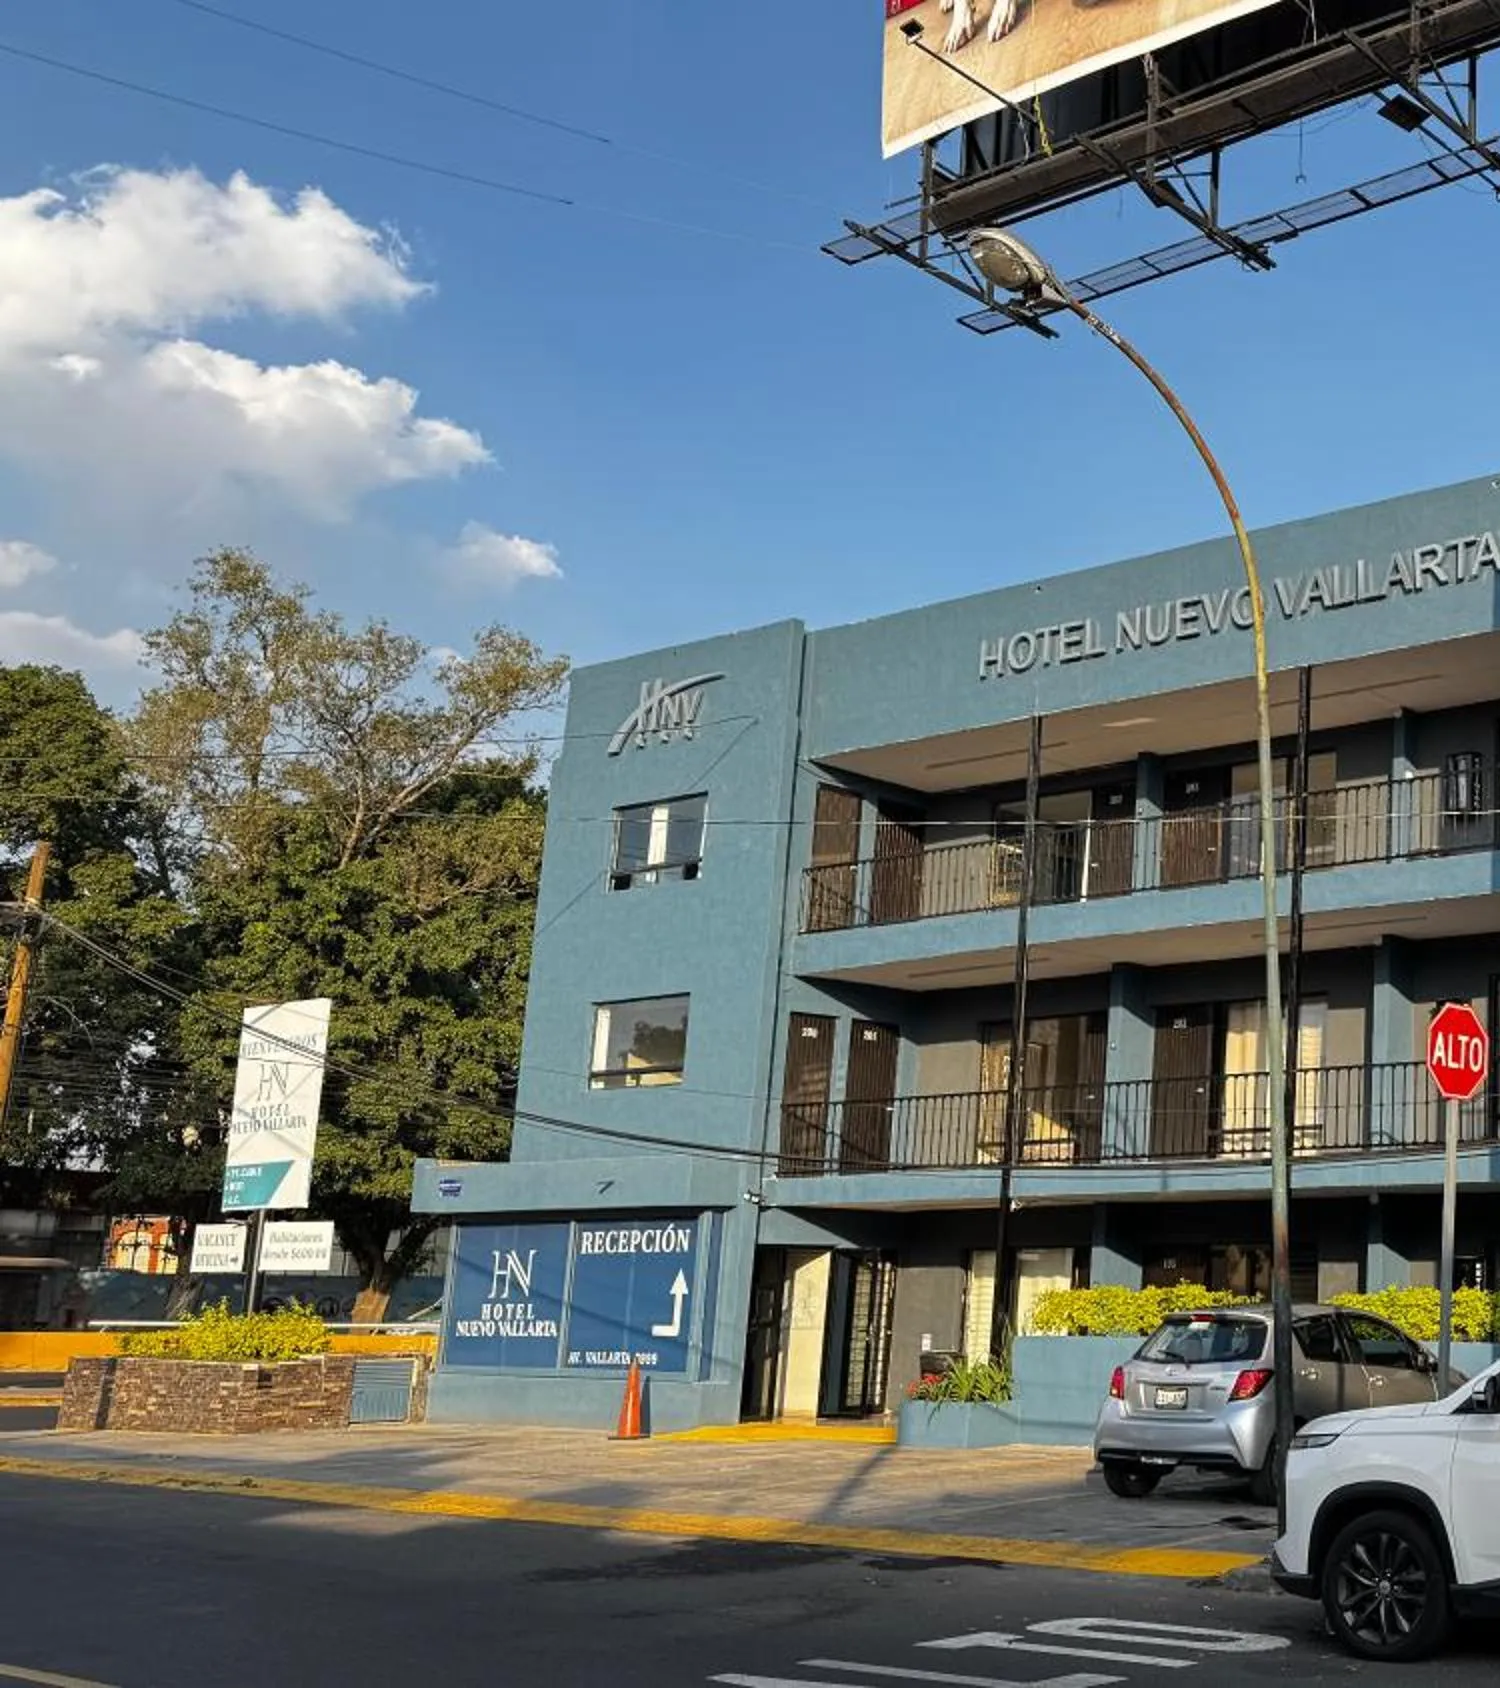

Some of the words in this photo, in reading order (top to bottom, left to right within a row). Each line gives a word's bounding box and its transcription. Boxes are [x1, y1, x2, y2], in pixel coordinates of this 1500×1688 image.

[978, 617, 1106, 681] HOTEL
[1113, 584, 1263, 652] NUEVO
[1432, 1032, 1483, 1073] ALTO
[581, 1223, 691, 1255] RECEPCIÓN
[481, 1303, 535, 1320] HOTEL
[455, 1320, 495, 1337] NUEVO
[496, 1319, 558, 1338] VALLARTA
[585, 1350, 631, 1365] VALLARTA
[707, 1617, 1292, 1688] LTO
